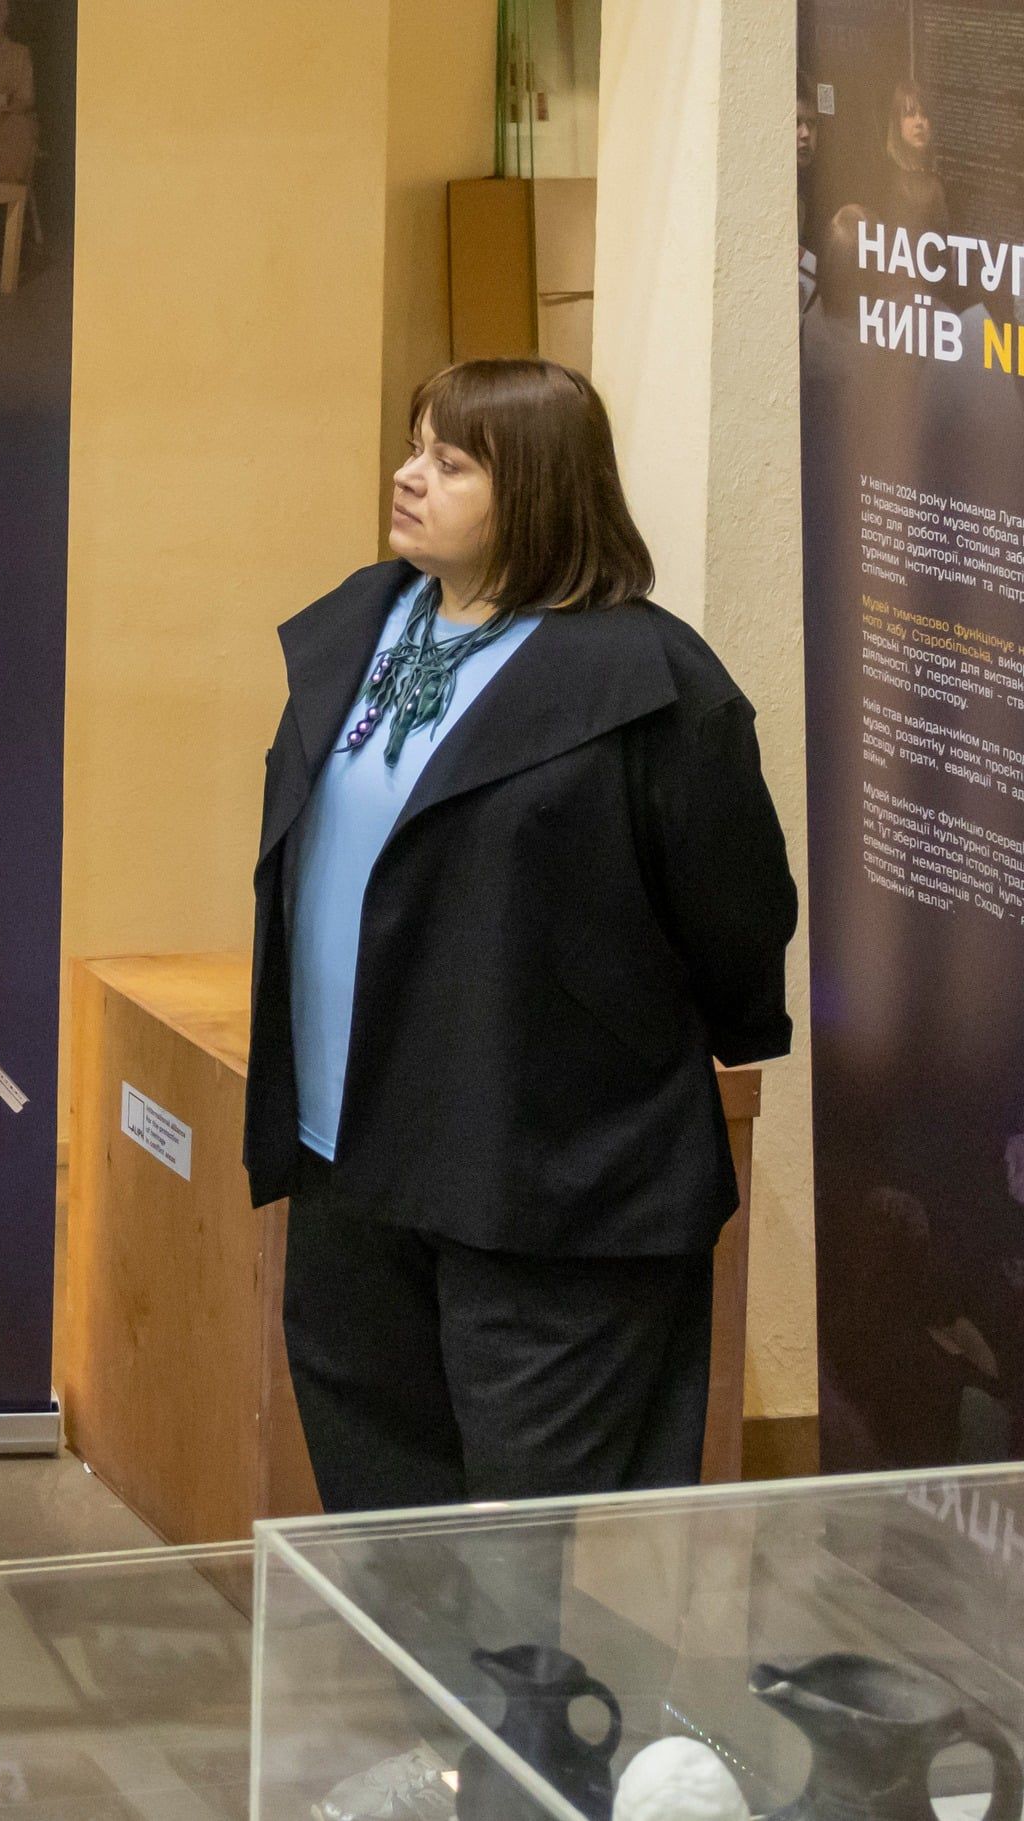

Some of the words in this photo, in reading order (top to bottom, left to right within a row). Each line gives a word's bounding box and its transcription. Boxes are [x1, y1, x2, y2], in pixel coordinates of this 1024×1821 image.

[859, 293, 964, 363] КИЇВ
[896, 484, 917, 501] 2024
[920, 494, 947, 511] року
[950, 498, 996, 520] команда
[908, 526, 950, 544] роботи.
[956, 535, 1000, 557] Столиця
[944, 517, 980, 534] музею
[982, 526, 1019, 545] обрала
